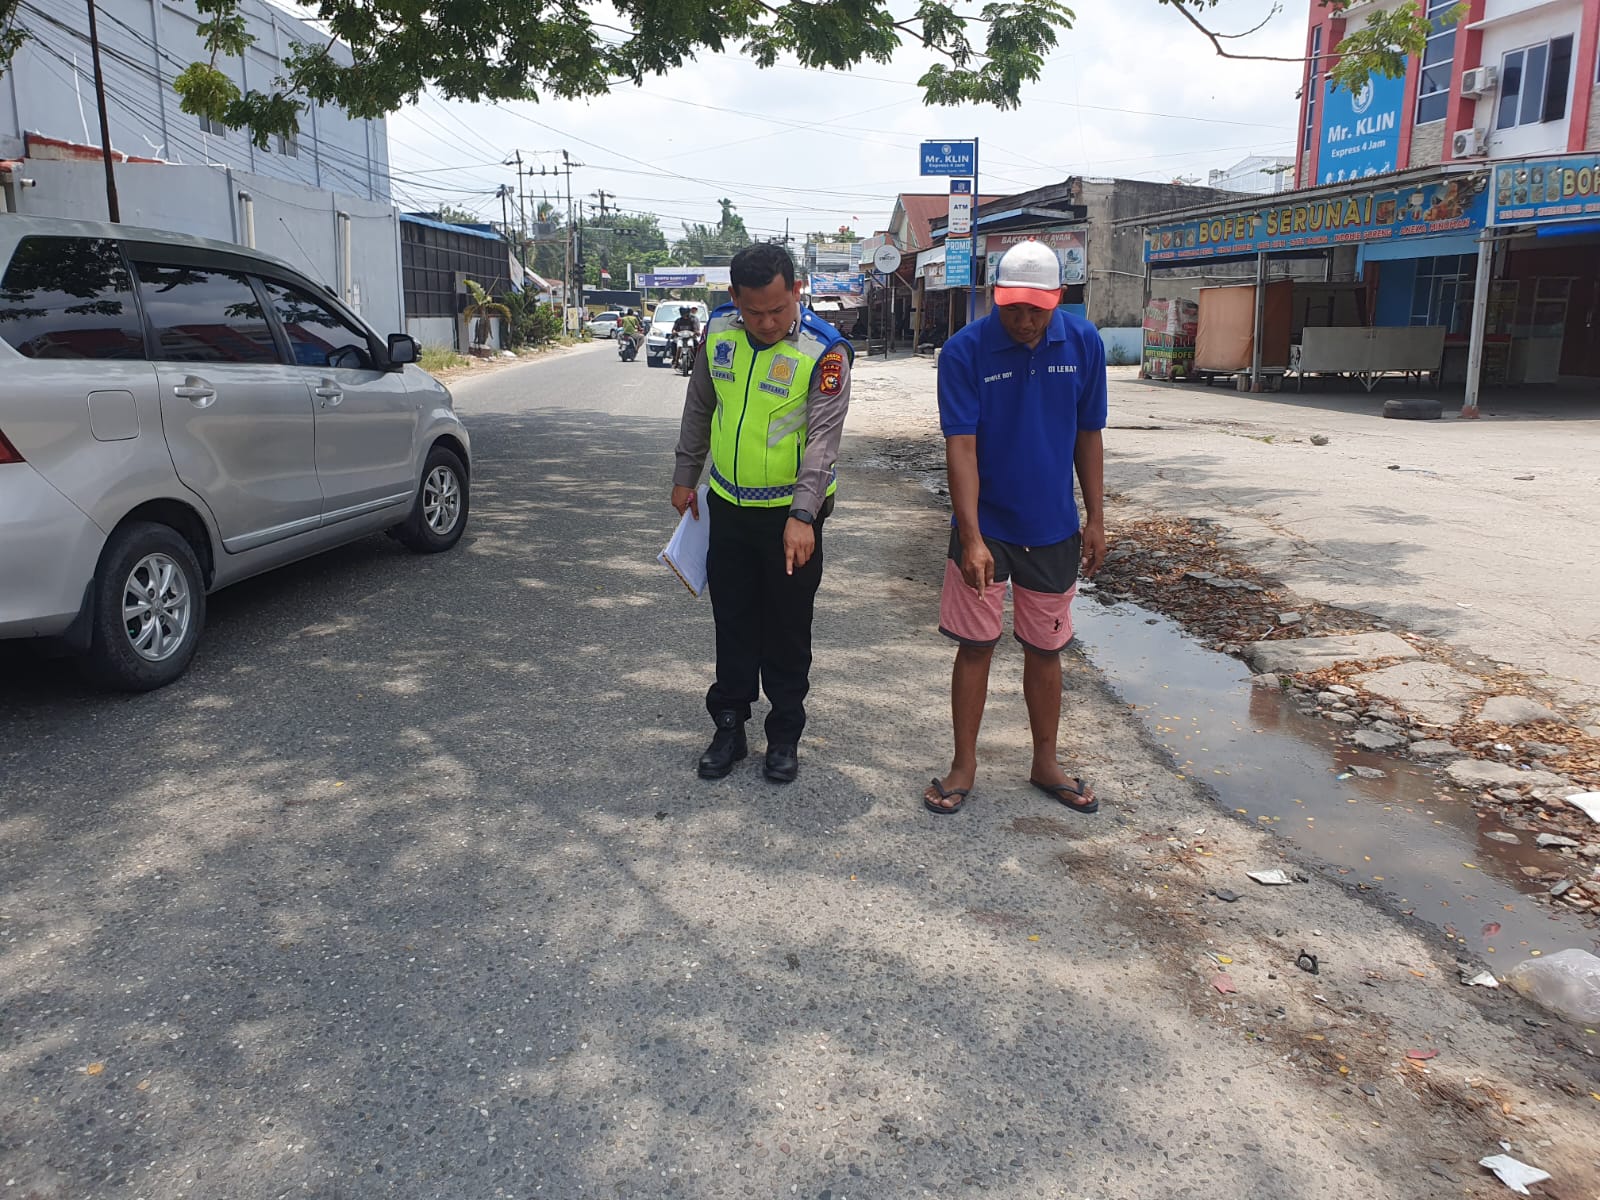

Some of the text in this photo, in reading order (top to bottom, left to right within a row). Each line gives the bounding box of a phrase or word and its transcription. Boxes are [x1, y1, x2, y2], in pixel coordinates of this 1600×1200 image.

[1328, 111, 1395, 143] Mr. KLIN
[925, 155, 969, 163] Mr. KLIN
[1332, 139, 1386, 159] Express 4 Jam
[1199, 197, 1374, 244] BOFET SERUNAI
[945, 241, 970, 250] PROMO
